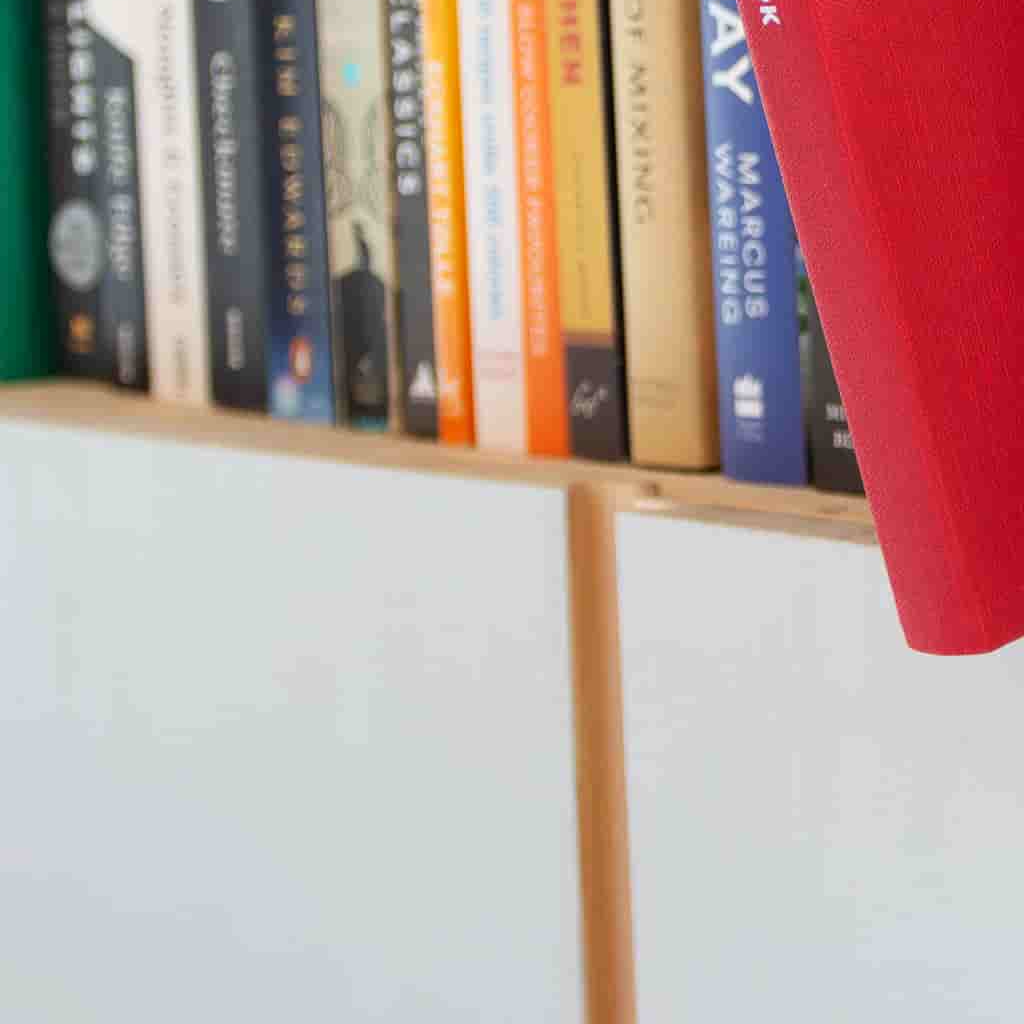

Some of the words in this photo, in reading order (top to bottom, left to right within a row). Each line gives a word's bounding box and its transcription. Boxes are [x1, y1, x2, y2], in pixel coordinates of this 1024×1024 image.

[628, 65, 655, 226] MIXING
[714, 144, 742, 325] WAREING
[738, 151, 770, 320] MARCUS
